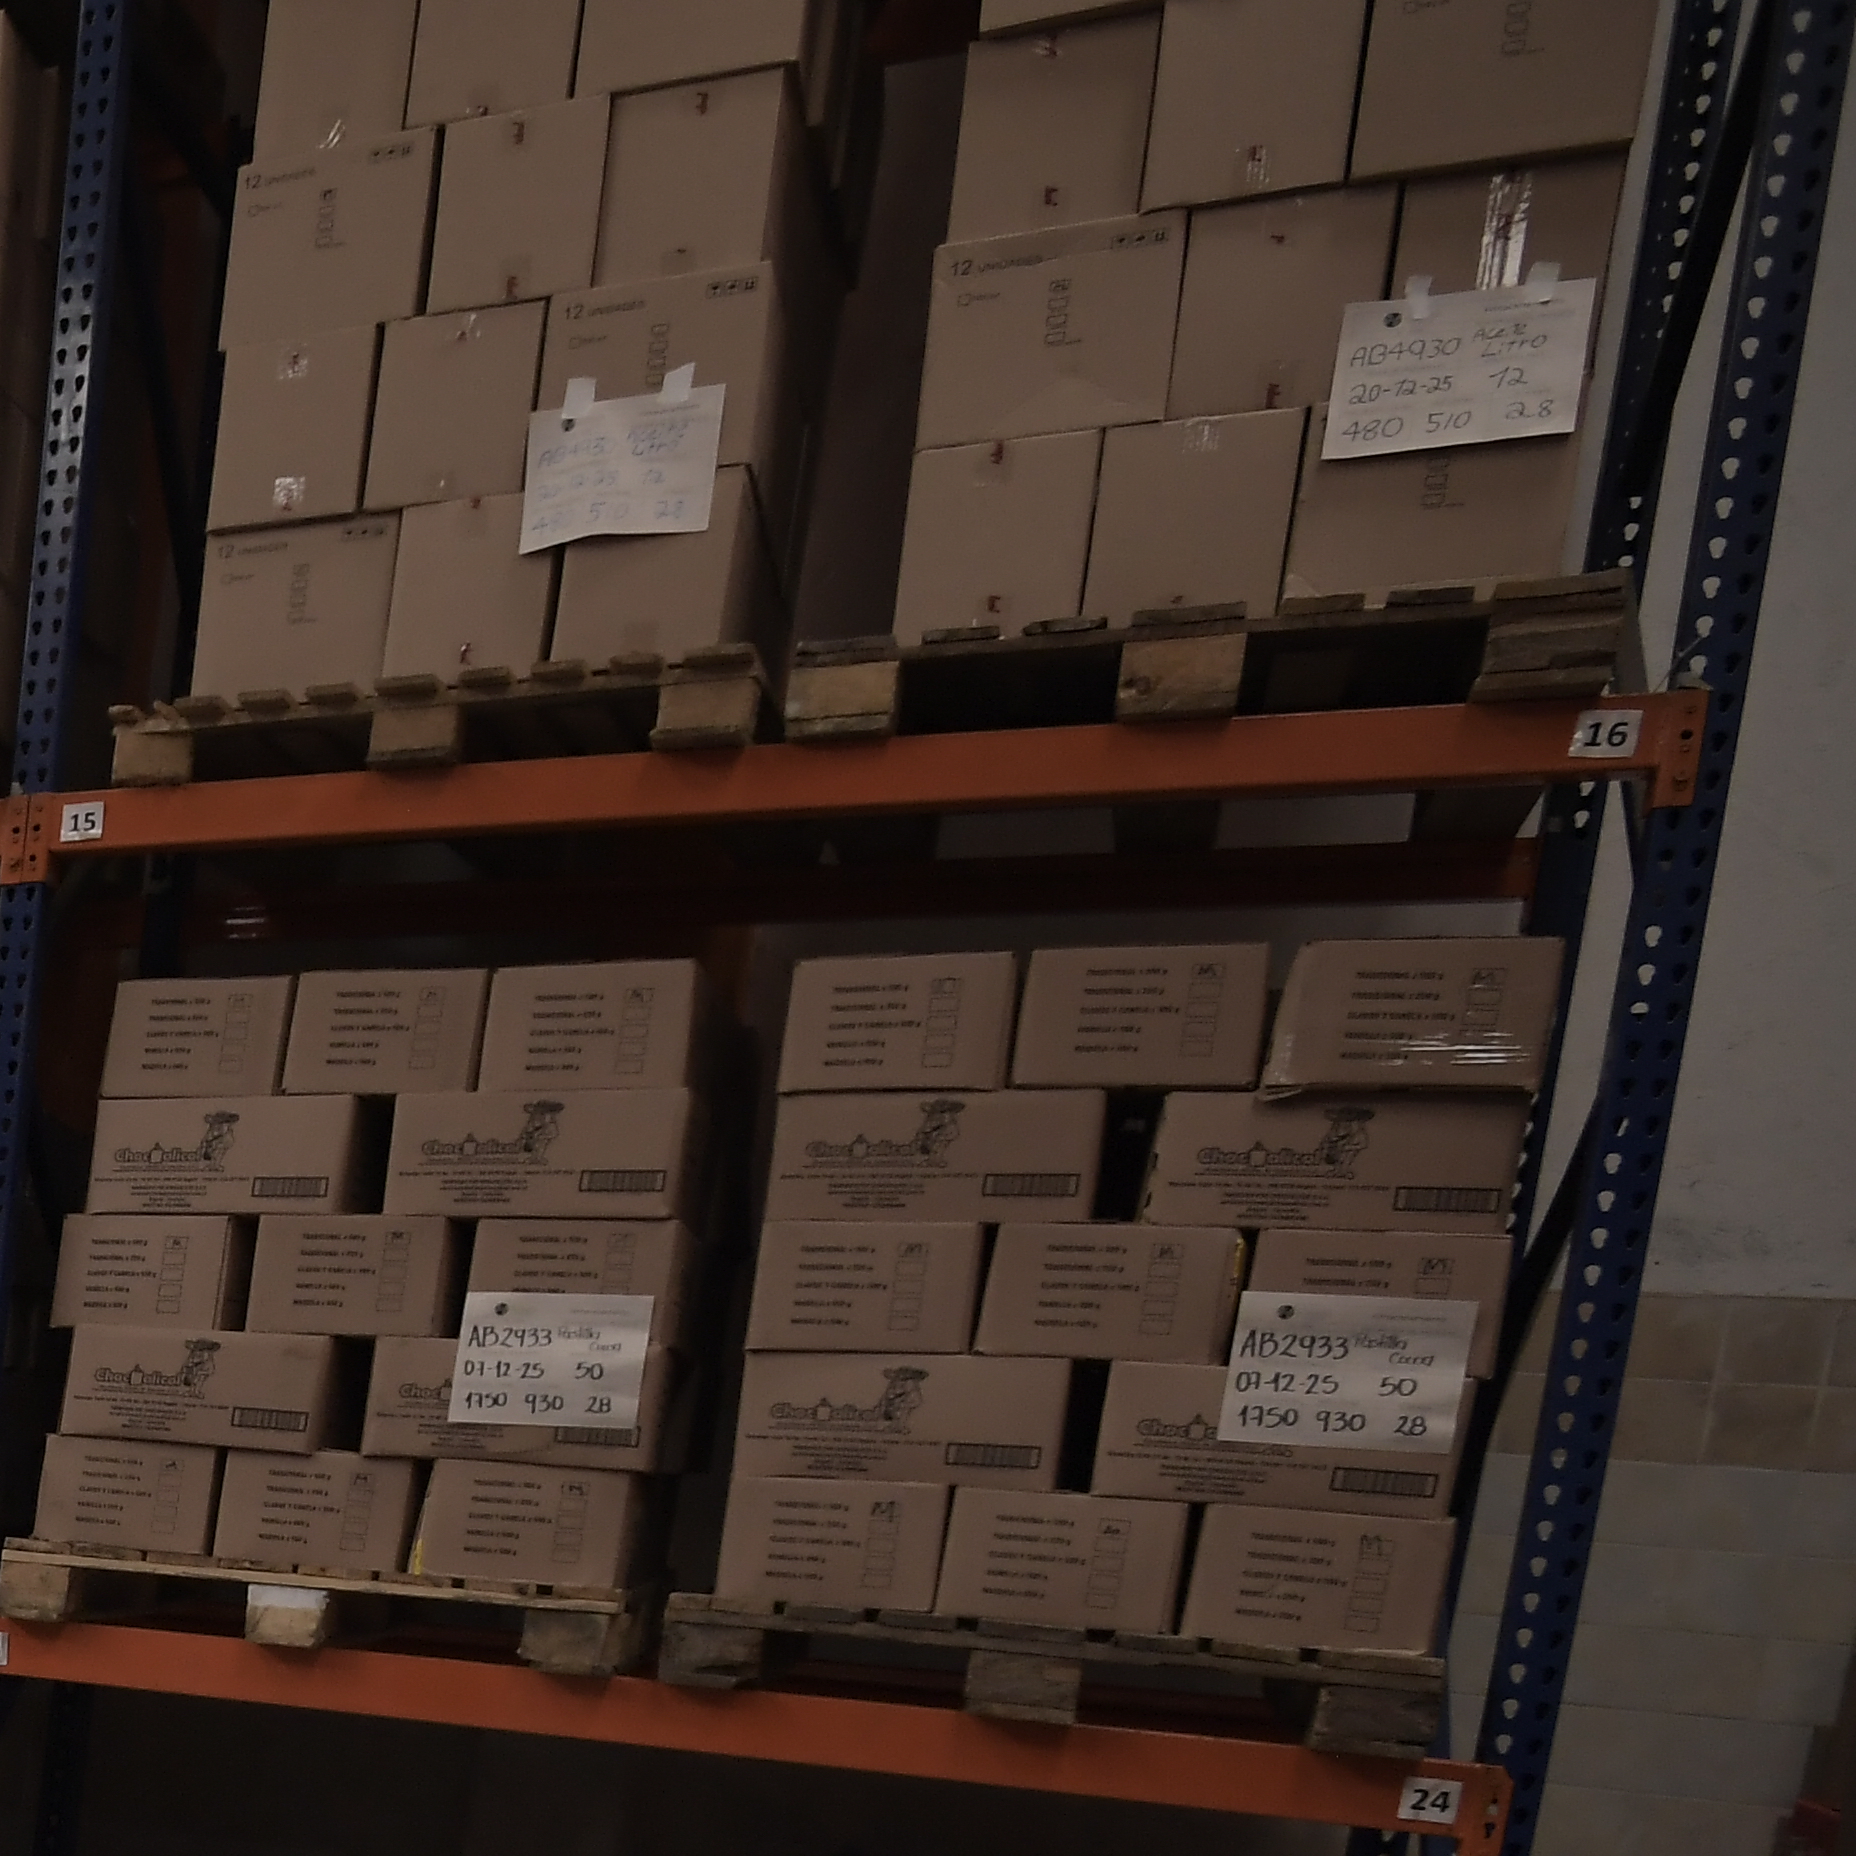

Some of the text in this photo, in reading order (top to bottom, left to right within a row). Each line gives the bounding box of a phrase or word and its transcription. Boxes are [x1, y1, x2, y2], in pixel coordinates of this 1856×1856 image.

[1349, 337, 1462, 367] AB4930
[1341, 417, 1404, 441] 480
[1585, 721, 1628, 748] 16
[70, 812, 97, 833] 15
[468, 1325, 553, 1348] AB2933
[1240, 1329, 1349, 1360] AB2933
[575, 1361, 603, 1380] 50
[1378, 1377, 1418, 1396] 50
[525, 1393, 564, 1414] 930
[585, 1396, 612, 1413] 28
[1238, 1406, 1427, 1436] 1750 930 28
[1412, 1788, 1450, 1814] 24
